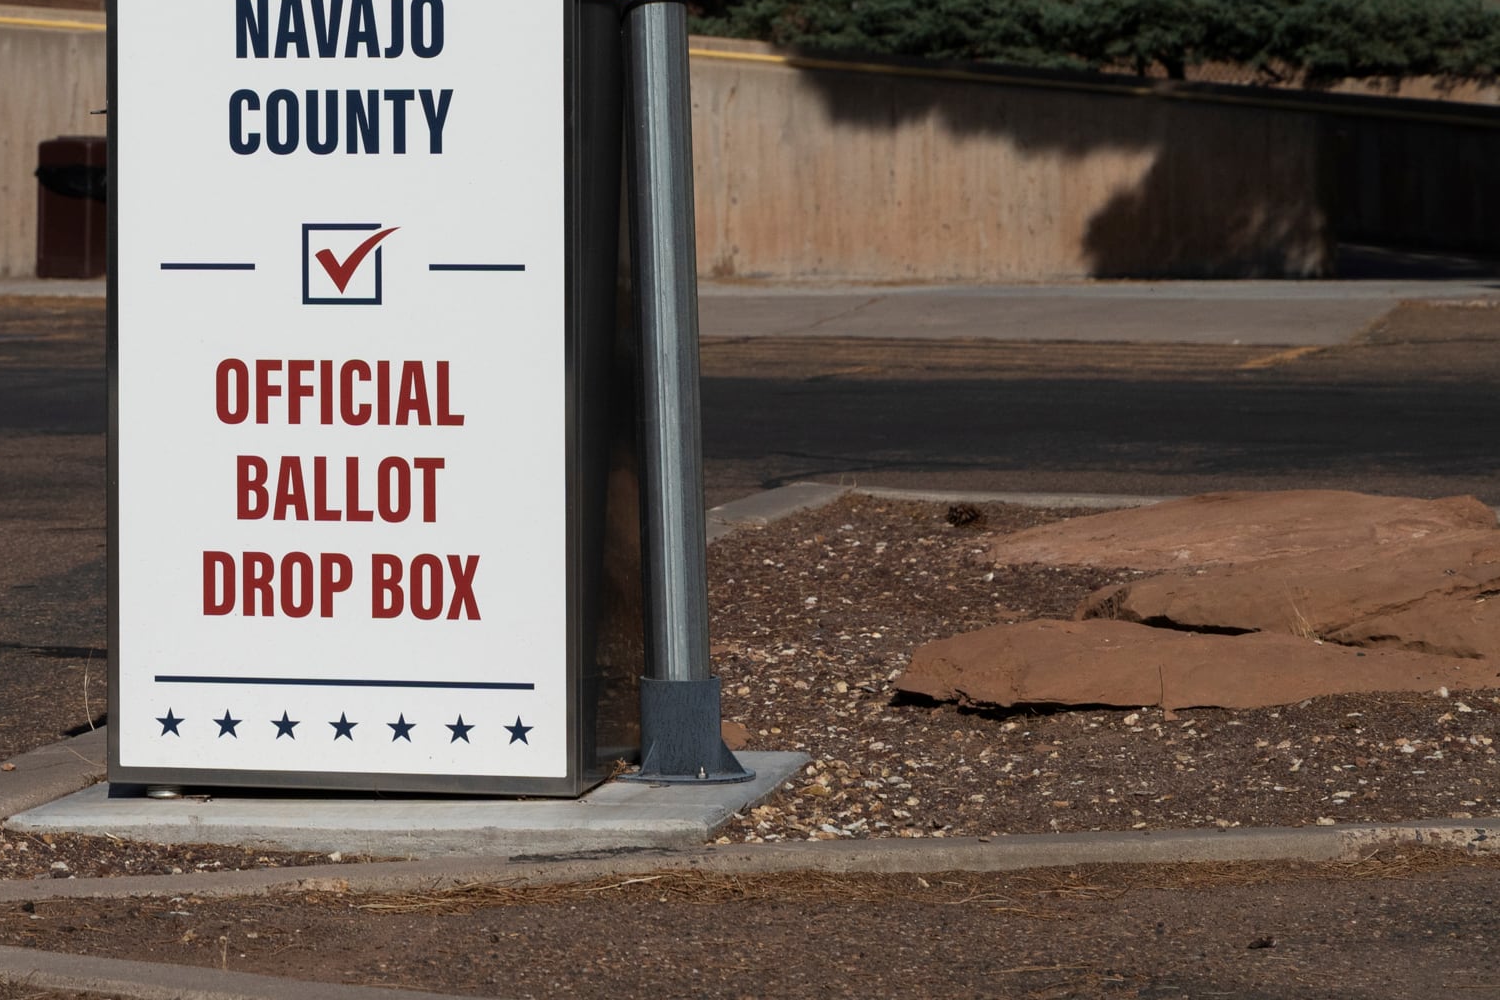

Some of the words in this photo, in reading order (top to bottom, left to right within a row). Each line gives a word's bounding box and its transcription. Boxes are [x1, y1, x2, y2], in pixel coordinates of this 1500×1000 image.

[228, 88, 454, 156] COUNTY
[215, 358, 465, 427] OFFICIAL
[236, 454, 446, 524] BALLOT
[202, 550, 353, 619] DROP
[371, 553, 482, 621] BOX
